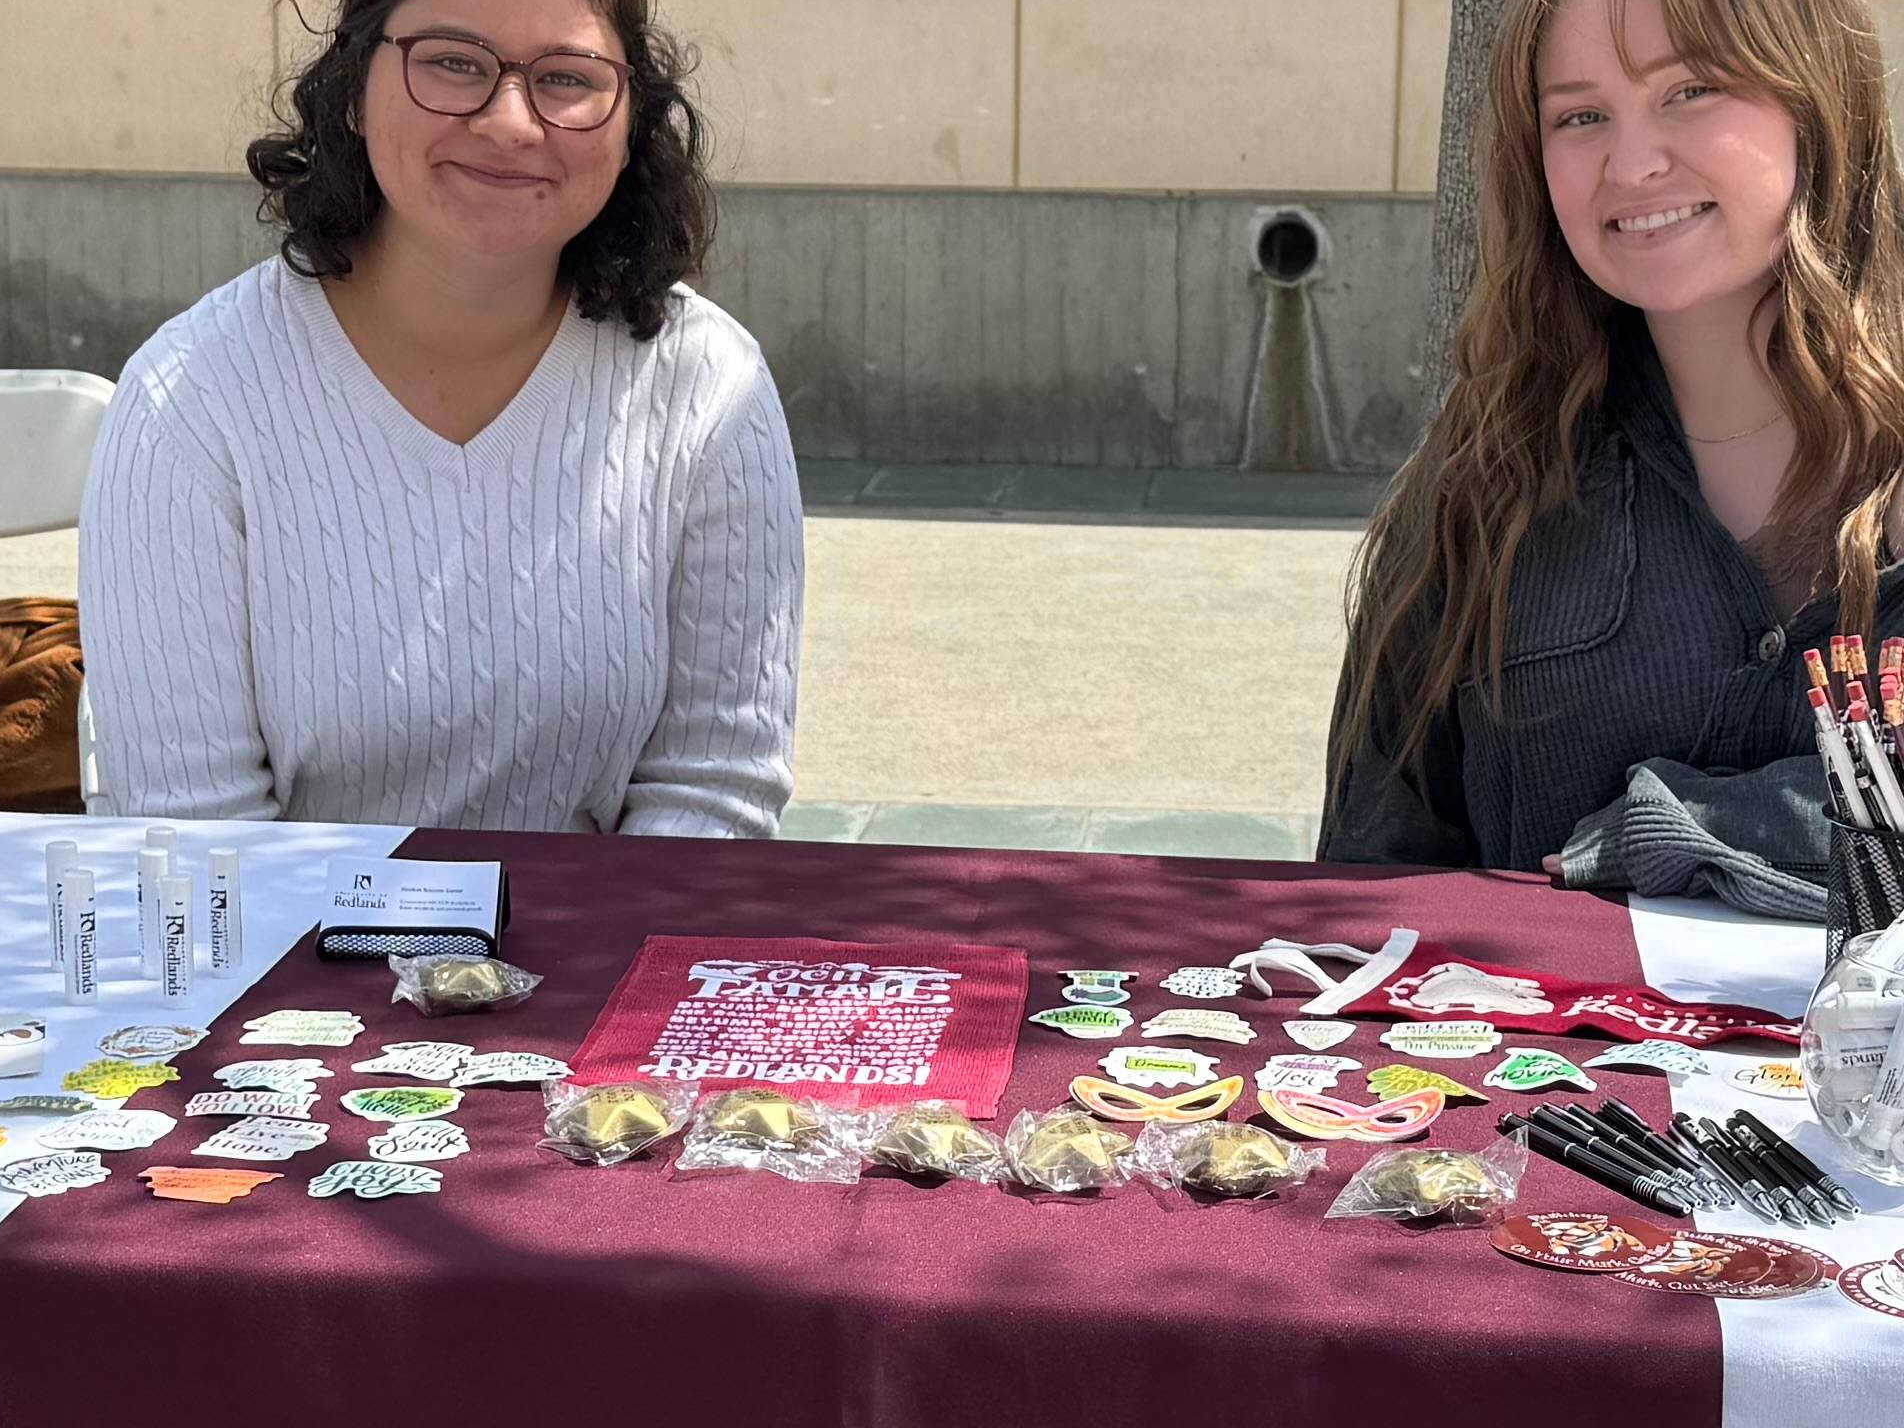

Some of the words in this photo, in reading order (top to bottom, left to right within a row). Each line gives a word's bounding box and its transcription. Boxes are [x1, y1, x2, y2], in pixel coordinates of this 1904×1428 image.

[334, 895, 386, 909] Redlands
[80, 935, 94, 994] Redlands
[166, 937, 181, 996] Redlands
[638, 1056, 931, 1086] REDLANDS!
[190, 1104, 240, 1114] YOU
[243, 1103, 303, 1116] LOVE
[194, 1092, 232, 1103] DO
[242, 1093, 313, 1106] WHAT
